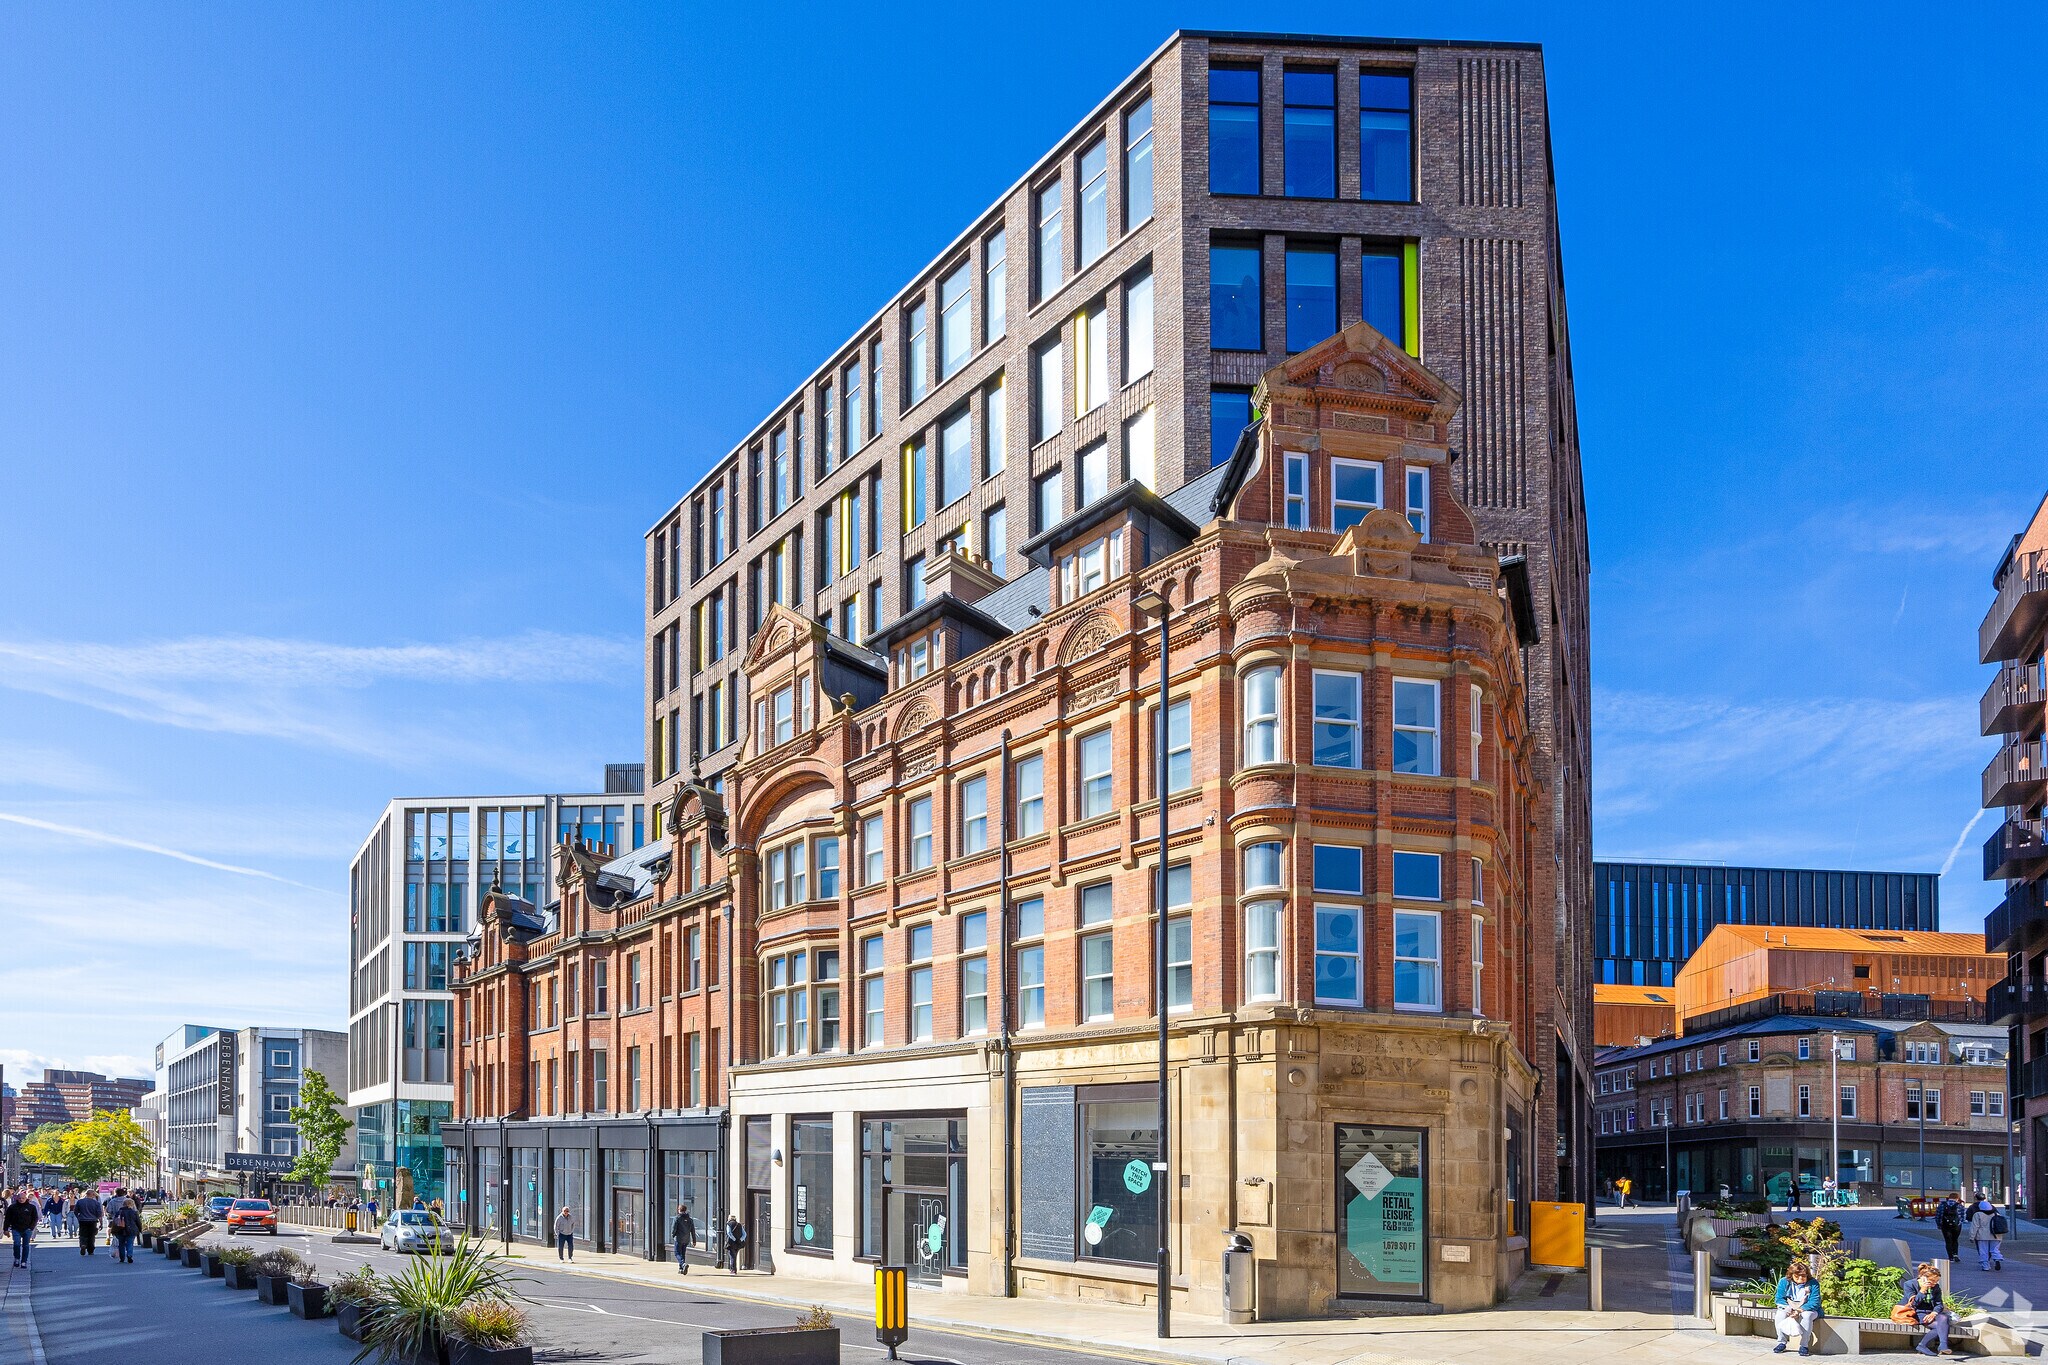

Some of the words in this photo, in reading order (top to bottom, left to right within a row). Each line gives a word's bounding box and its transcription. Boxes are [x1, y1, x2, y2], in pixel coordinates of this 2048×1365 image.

[222, 1036, 232, 1110] DEBENHAMS
[229, 1157, 292, 1169] DEBENHAMS
[1130, 1164, 1148, 1178] WATCH
[1131, 1171, 1143, 1182] THIS
[1127, 1176, 1143, 1188] SPACE
[1383, 1197, 1414, 1211] RETAIL,
[1382, 1210, 1415, 1222] LEISURE,
[1382, 1221, 1398, 1232] F&B
[1399, 1241, 1407, 1252] SQ
[1408, 1242, 1416, 1250] FT
